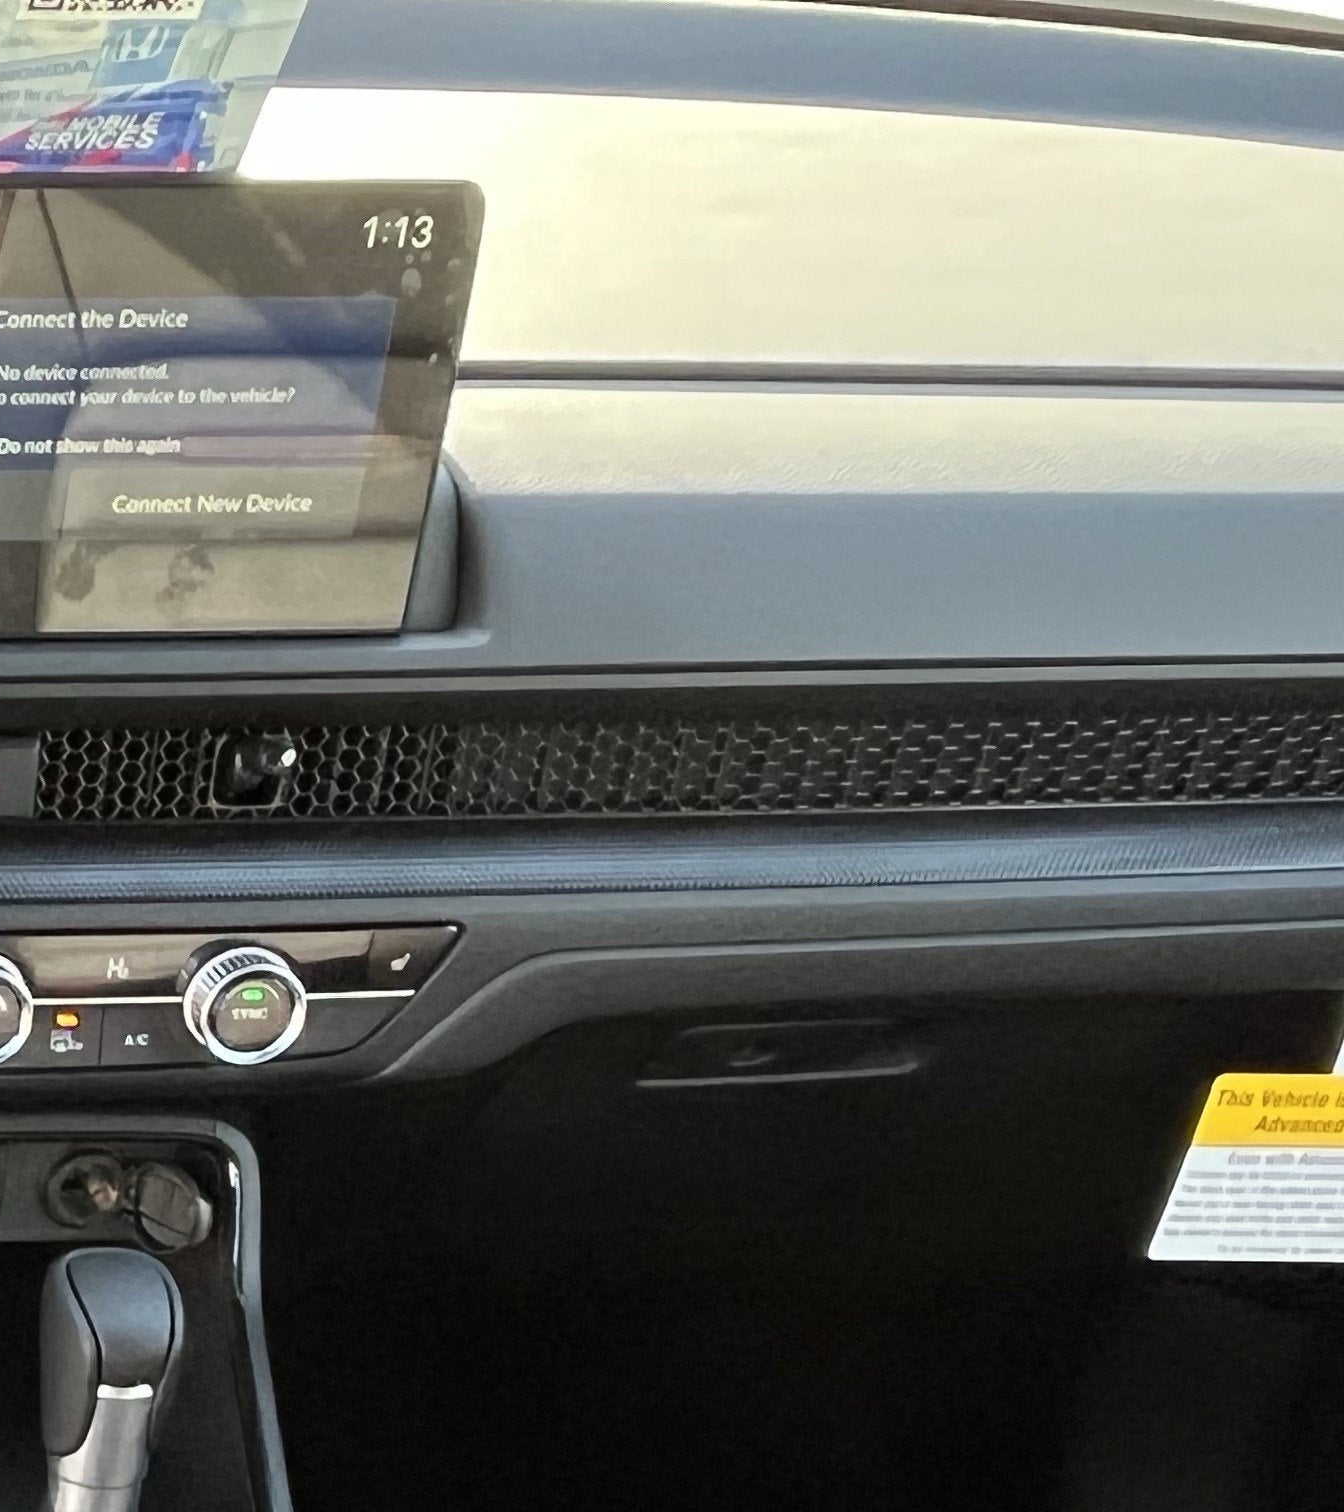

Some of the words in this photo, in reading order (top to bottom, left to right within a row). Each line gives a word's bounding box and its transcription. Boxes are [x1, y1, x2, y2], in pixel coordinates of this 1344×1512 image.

[67, 111, 165, 133] MOBILE
[25, 129, 159, 151] SERVICES
[363, 215, 434, 249] 1:13
[81, 308, 114, 329] the
[118, 308, 189, 329] Device
[23, 363, 77, 381] device
[10, 390, 76, 406] connect
[80, 391, 118, 408] your
[122, 388, 174, 405] device
[178, 388, 196, 404] to
[199, 387, 226, 404] the
[24, 438, 52, 454] not
[56, 438, 100, 454] show
[136, 436, 181, 456] again
[112, 494, 191, 514] Connect
[197, 494, 243, 514] New
[246, 493, 313, 513] Device
[1217, 1089, 1254, 1107] This
[1262, 1090, 1329, 1108] Vehicle
